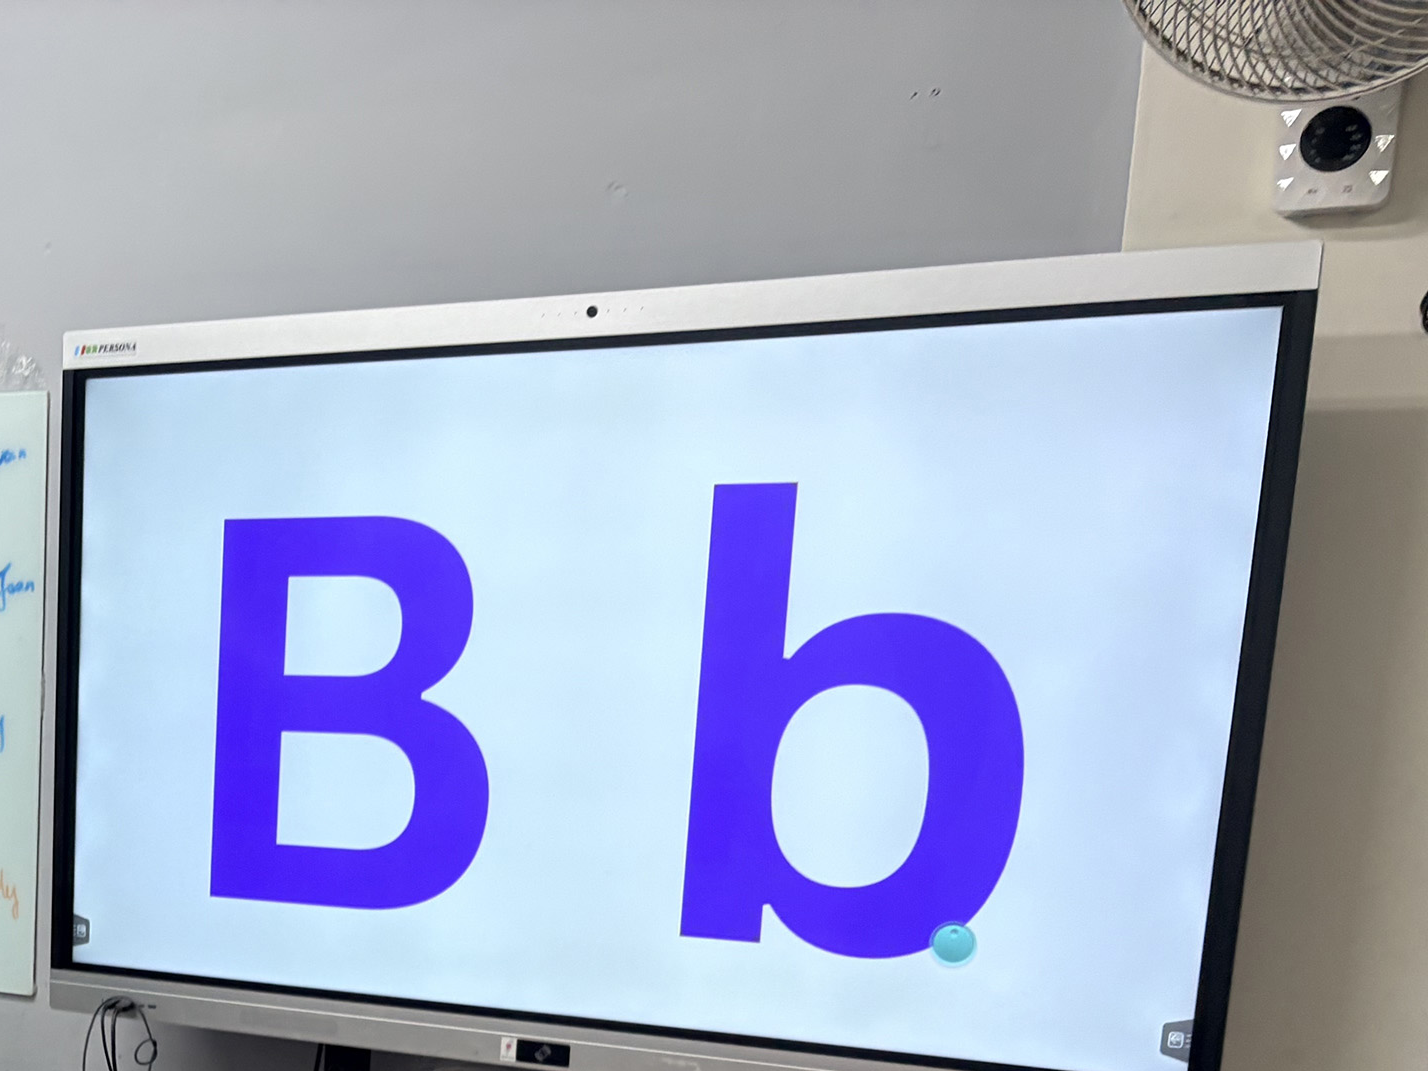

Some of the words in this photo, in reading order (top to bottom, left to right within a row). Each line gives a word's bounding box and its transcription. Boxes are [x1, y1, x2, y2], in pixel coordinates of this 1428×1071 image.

[98, 341, 138, 355] PERSONA
[210, 515, 489, 910] B
[680, 482, 1025, 960] b
